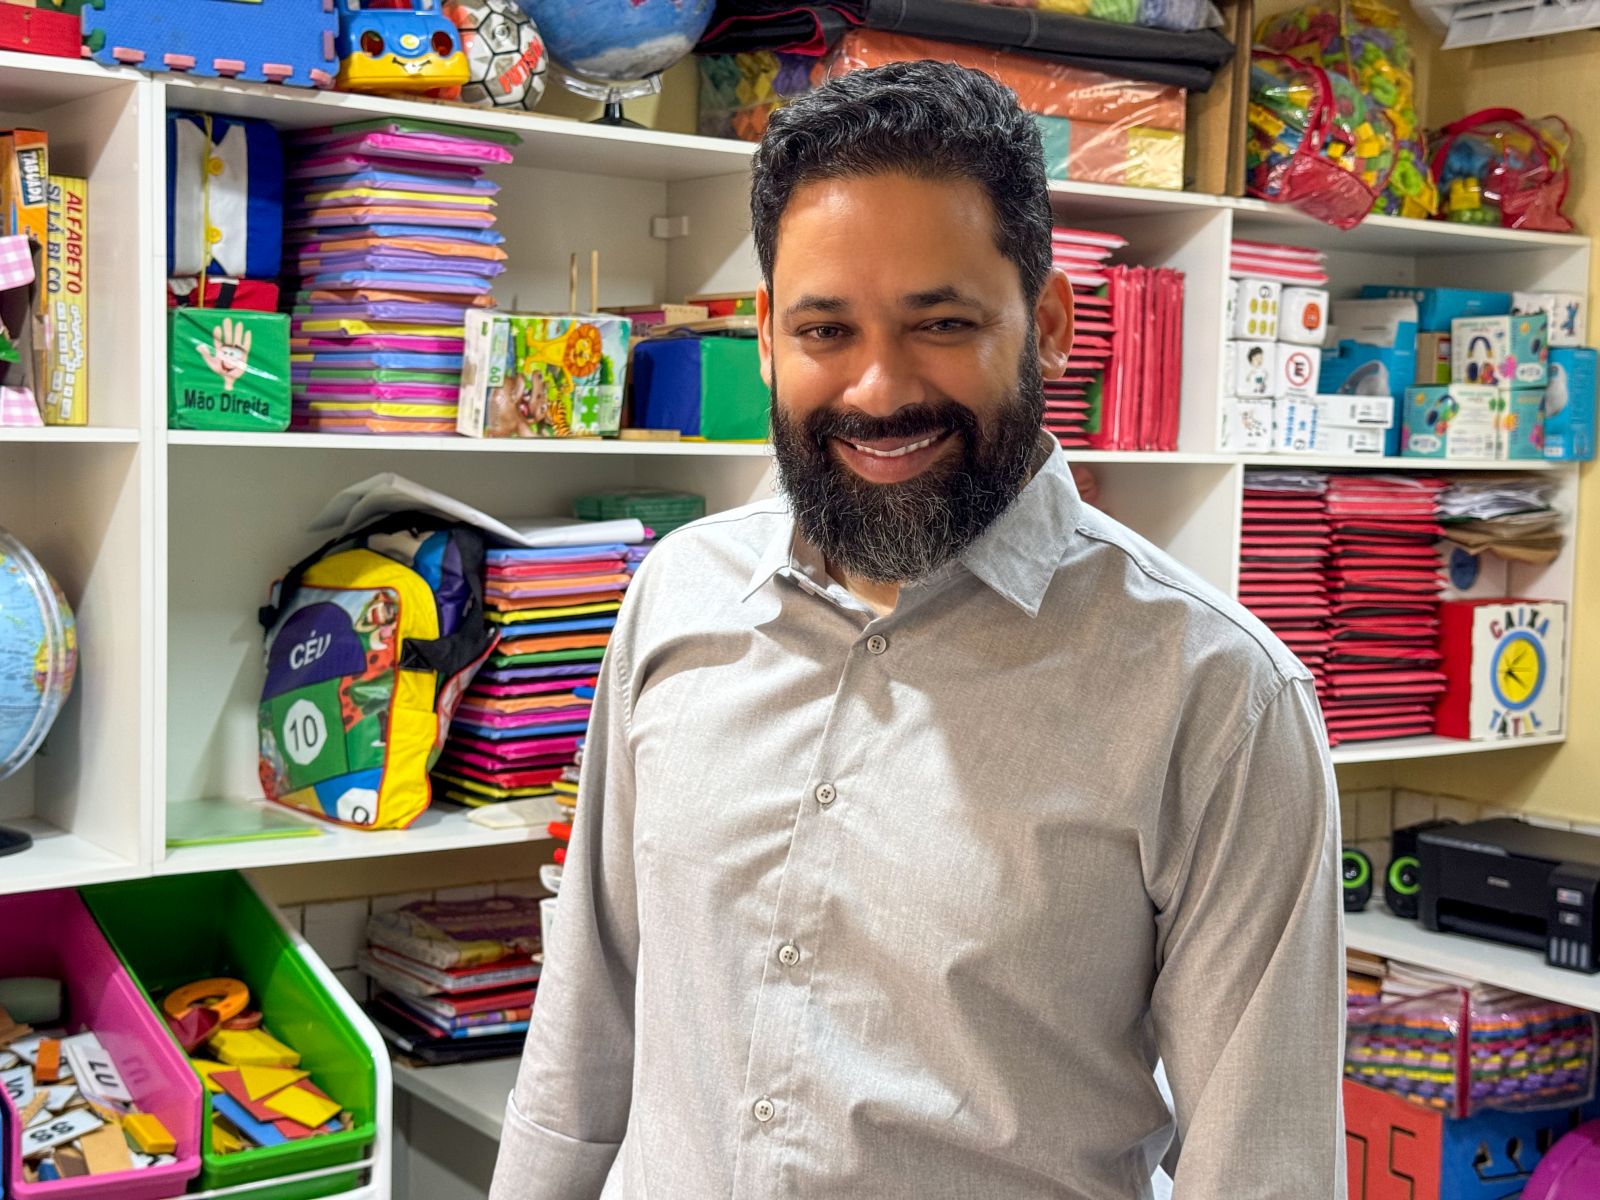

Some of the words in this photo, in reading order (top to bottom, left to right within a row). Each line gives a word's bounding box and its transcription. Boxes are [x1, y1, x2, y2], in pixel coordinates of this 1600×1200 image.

[20, 151, 42, 203] TABUADA
[66, 191, 83, 294] ALFABETO
[489, 367, 501, 383] 60
[184, 388, 215, 411] Mão
[220, 393, 270, 416] Direita
[1489, 607, 1550, 641] CAIXA
[290, 630, 332, 671] CÉU
[288, 714, 319, 752] 10
[88, 1060, 119, 1089] LU
